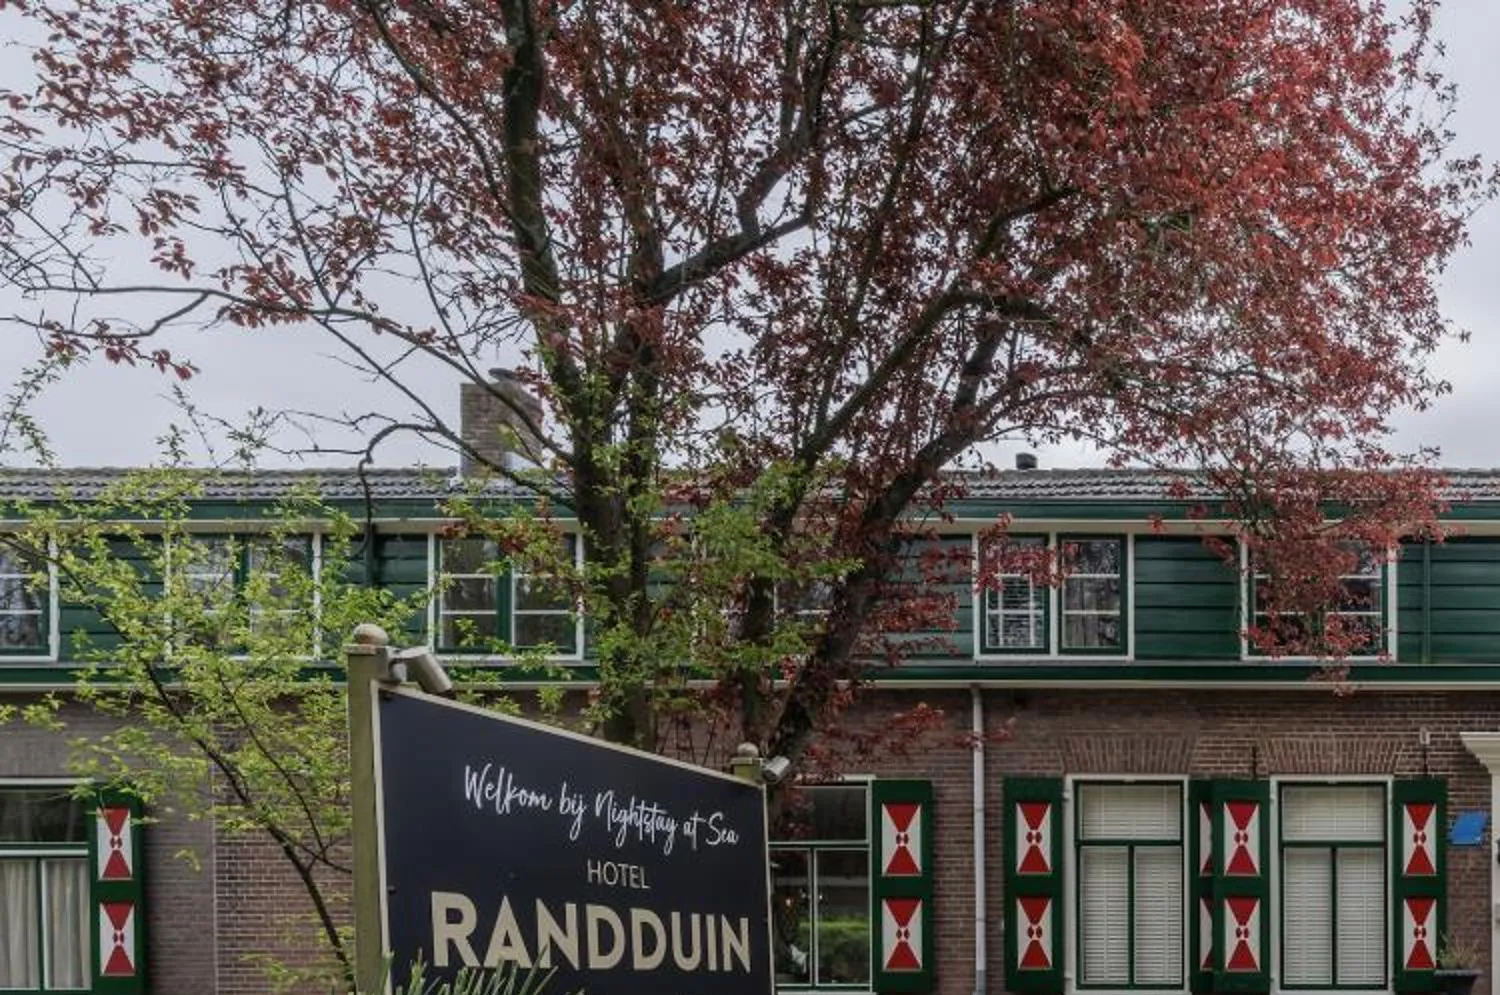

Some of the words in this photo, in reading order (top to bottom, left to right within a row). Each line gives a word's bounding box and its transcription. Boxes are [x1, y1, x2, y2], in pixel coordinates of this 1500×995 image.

[464, 763, 551, 814] Welkom
[560, 782, 587, 841] bij
[595, 790, 678, 855] Nightstay
[683, 811, 706, 849] at
[706, 812, 738, 846] Sea
[587, 859, 650, 889] HOTEL
[431, 891, 751, 974] RANDDUIN
